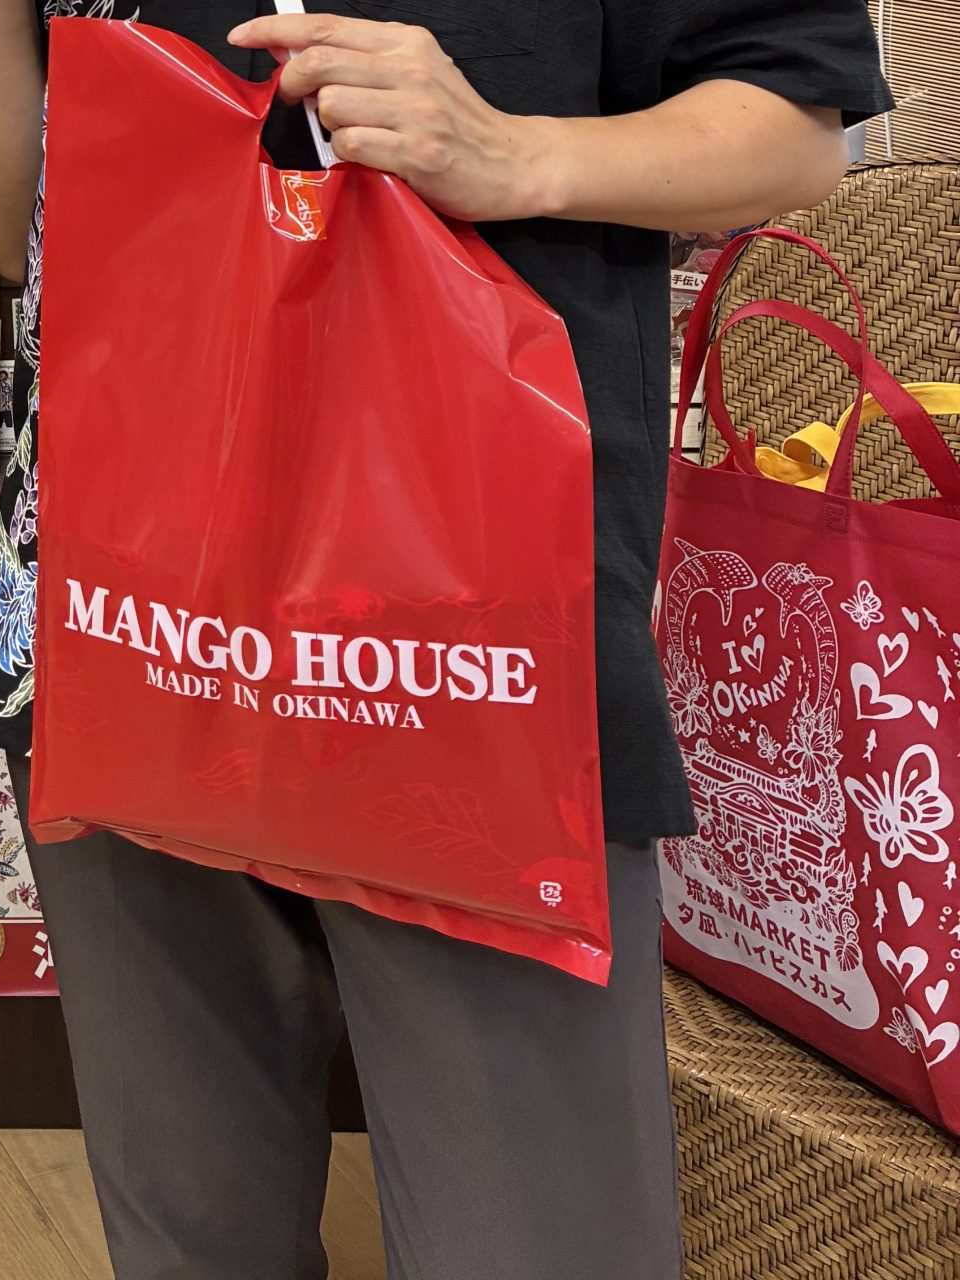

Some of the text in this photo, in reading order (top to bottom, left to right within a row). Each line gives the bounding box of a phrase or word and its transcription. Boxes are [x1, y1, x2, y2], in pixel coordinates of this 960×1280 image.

[65, 579, 537, 704] MANGO HOUSE
[722, 640, 741, 675] I
[146, 662, 424, 729] MADE IN OKINAWA
[713, 655, 794, 717] OKINAWA
